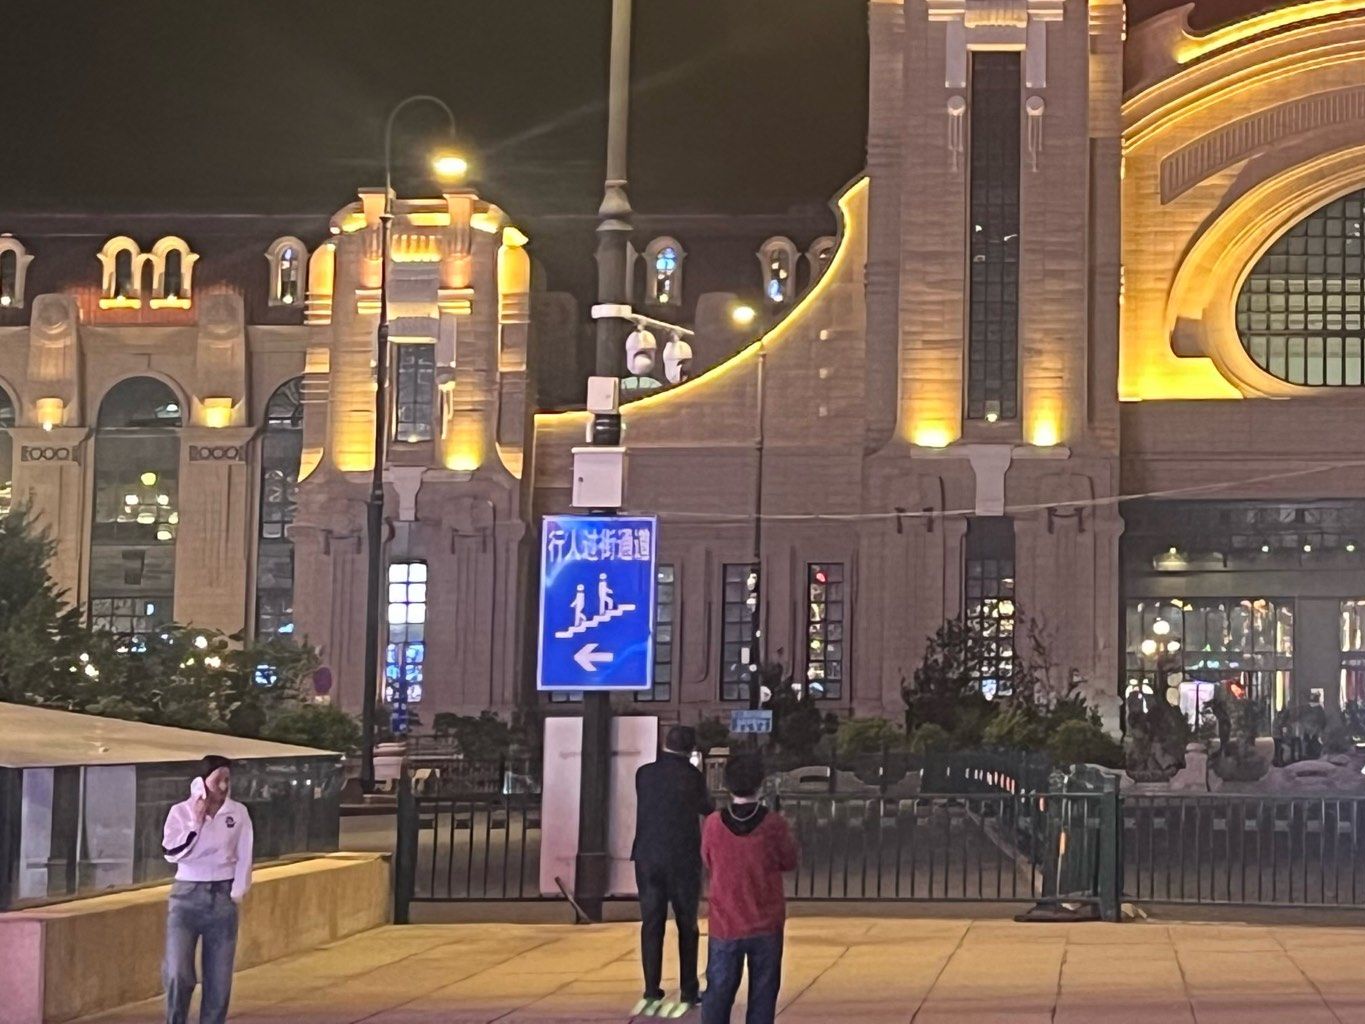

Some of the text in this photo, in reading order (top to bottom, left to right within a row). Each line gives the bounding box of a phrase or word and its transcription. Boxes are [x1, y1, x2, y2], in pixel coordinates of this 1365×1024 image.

[548, 528, 650, 563] 行人过街通道
